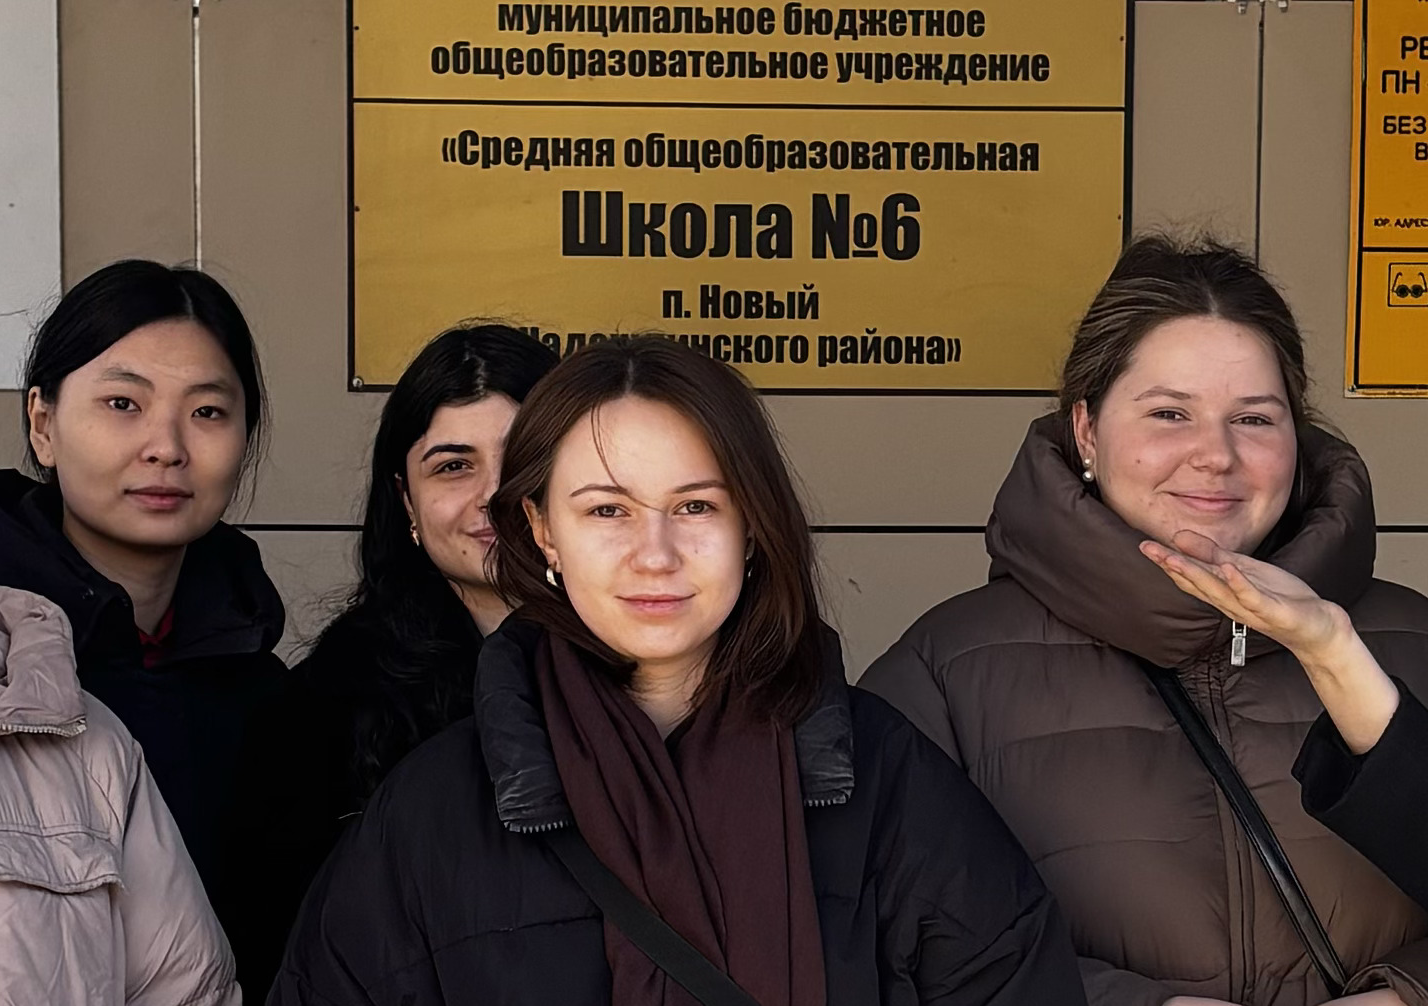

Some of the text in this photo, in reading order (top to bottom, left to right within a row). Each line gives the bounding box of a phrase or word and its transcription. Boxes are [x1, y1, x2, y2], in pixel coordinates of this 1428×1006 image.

[498, 2, 986, 40] муниципальное бюджетное
[431, 41, 1050, 84] общеобразовательное учреждение
[1381, 70, 1420, 94] ПН
[1383, 115, 1427, 135] БЕЗ
[441, 130, 1040, 173] «Средняя общеобразовательная
[562, 191, 921, 260] Школа №6
[663, 284, 819, 320] п. Новый
[817, 328, 962, 368] района»
